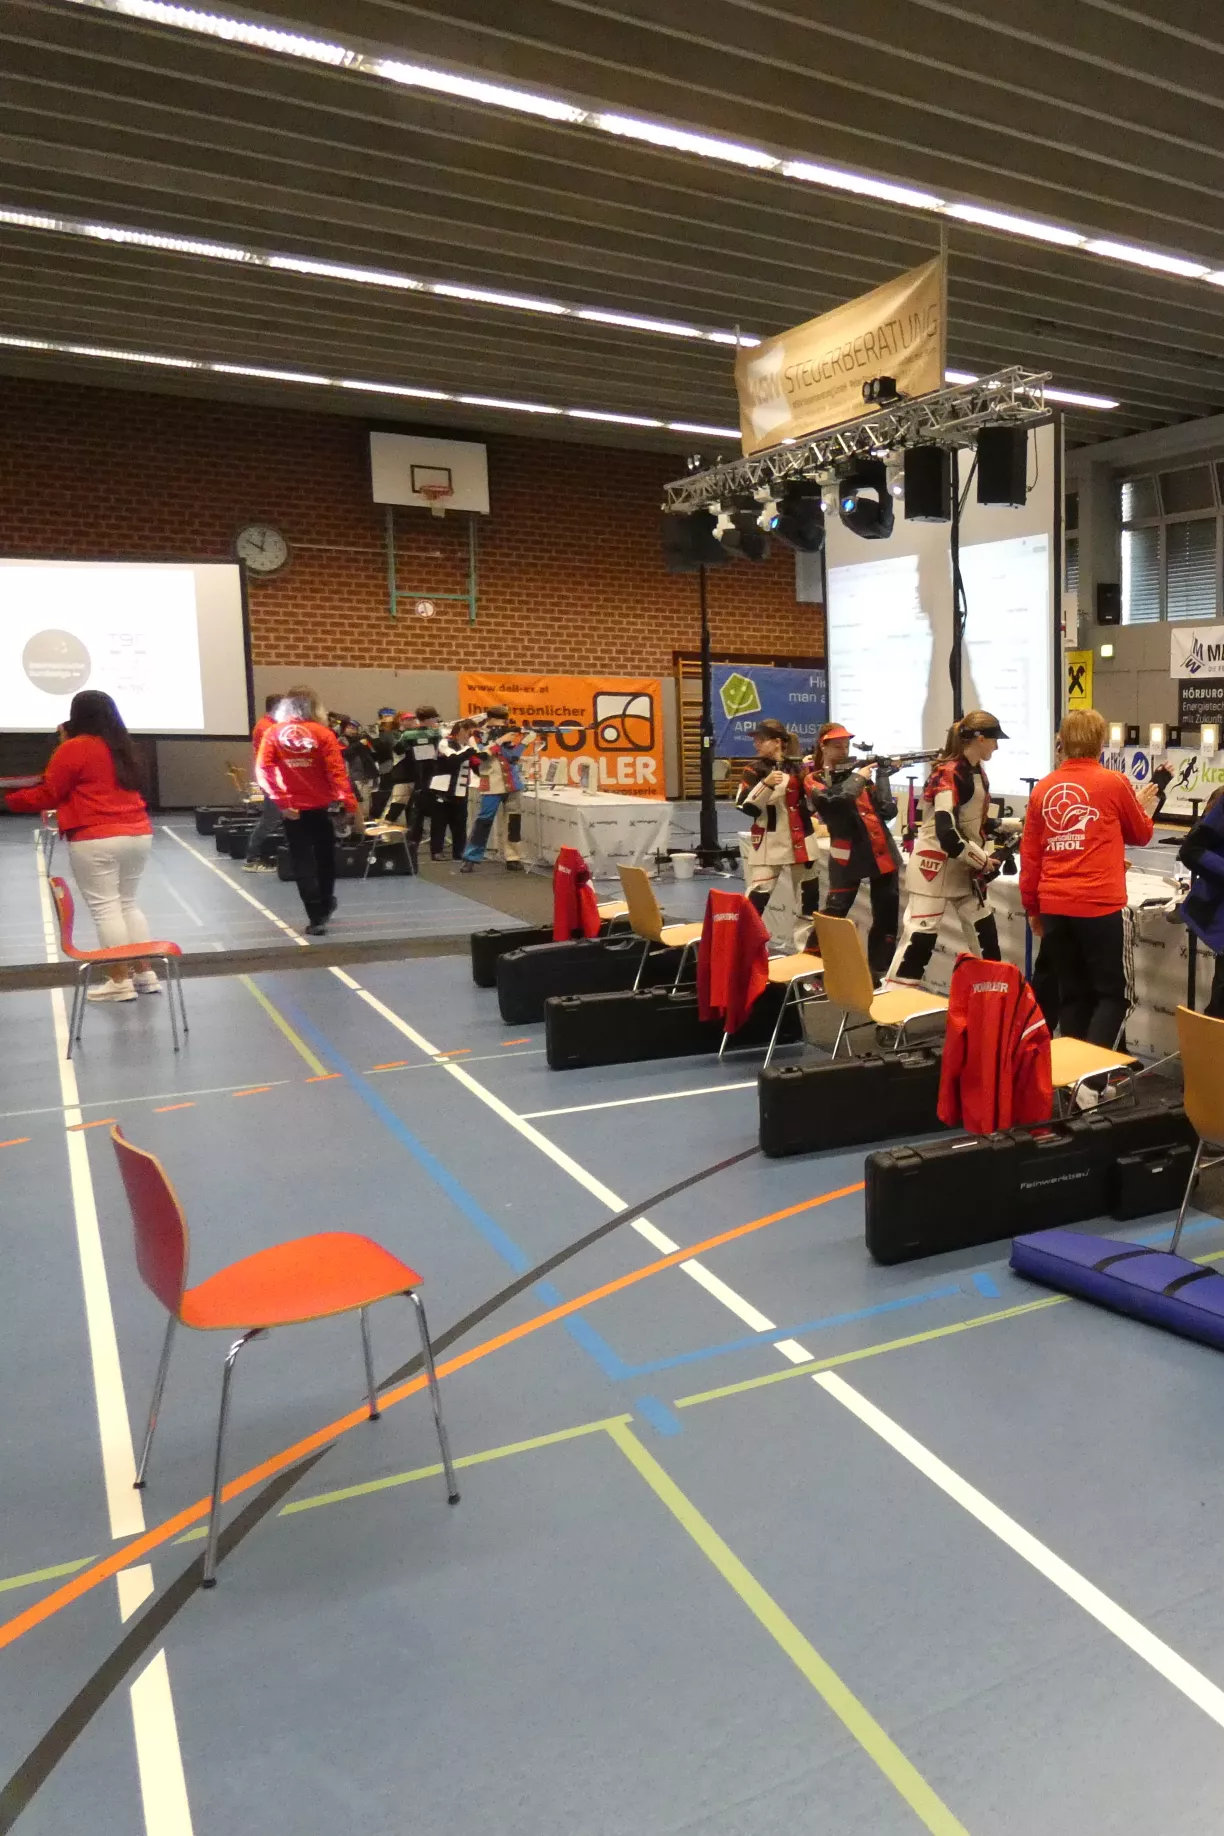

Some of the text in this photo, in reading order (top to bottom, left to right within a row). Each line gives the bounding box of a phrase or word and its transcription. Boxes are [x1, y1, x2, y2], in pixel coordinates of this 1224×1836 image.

[785, 304, 937, 394] STEUERBERATUNG
[1195, 713, 1223, 724] Zukunft
[920, 859, 941, 870] AUT
